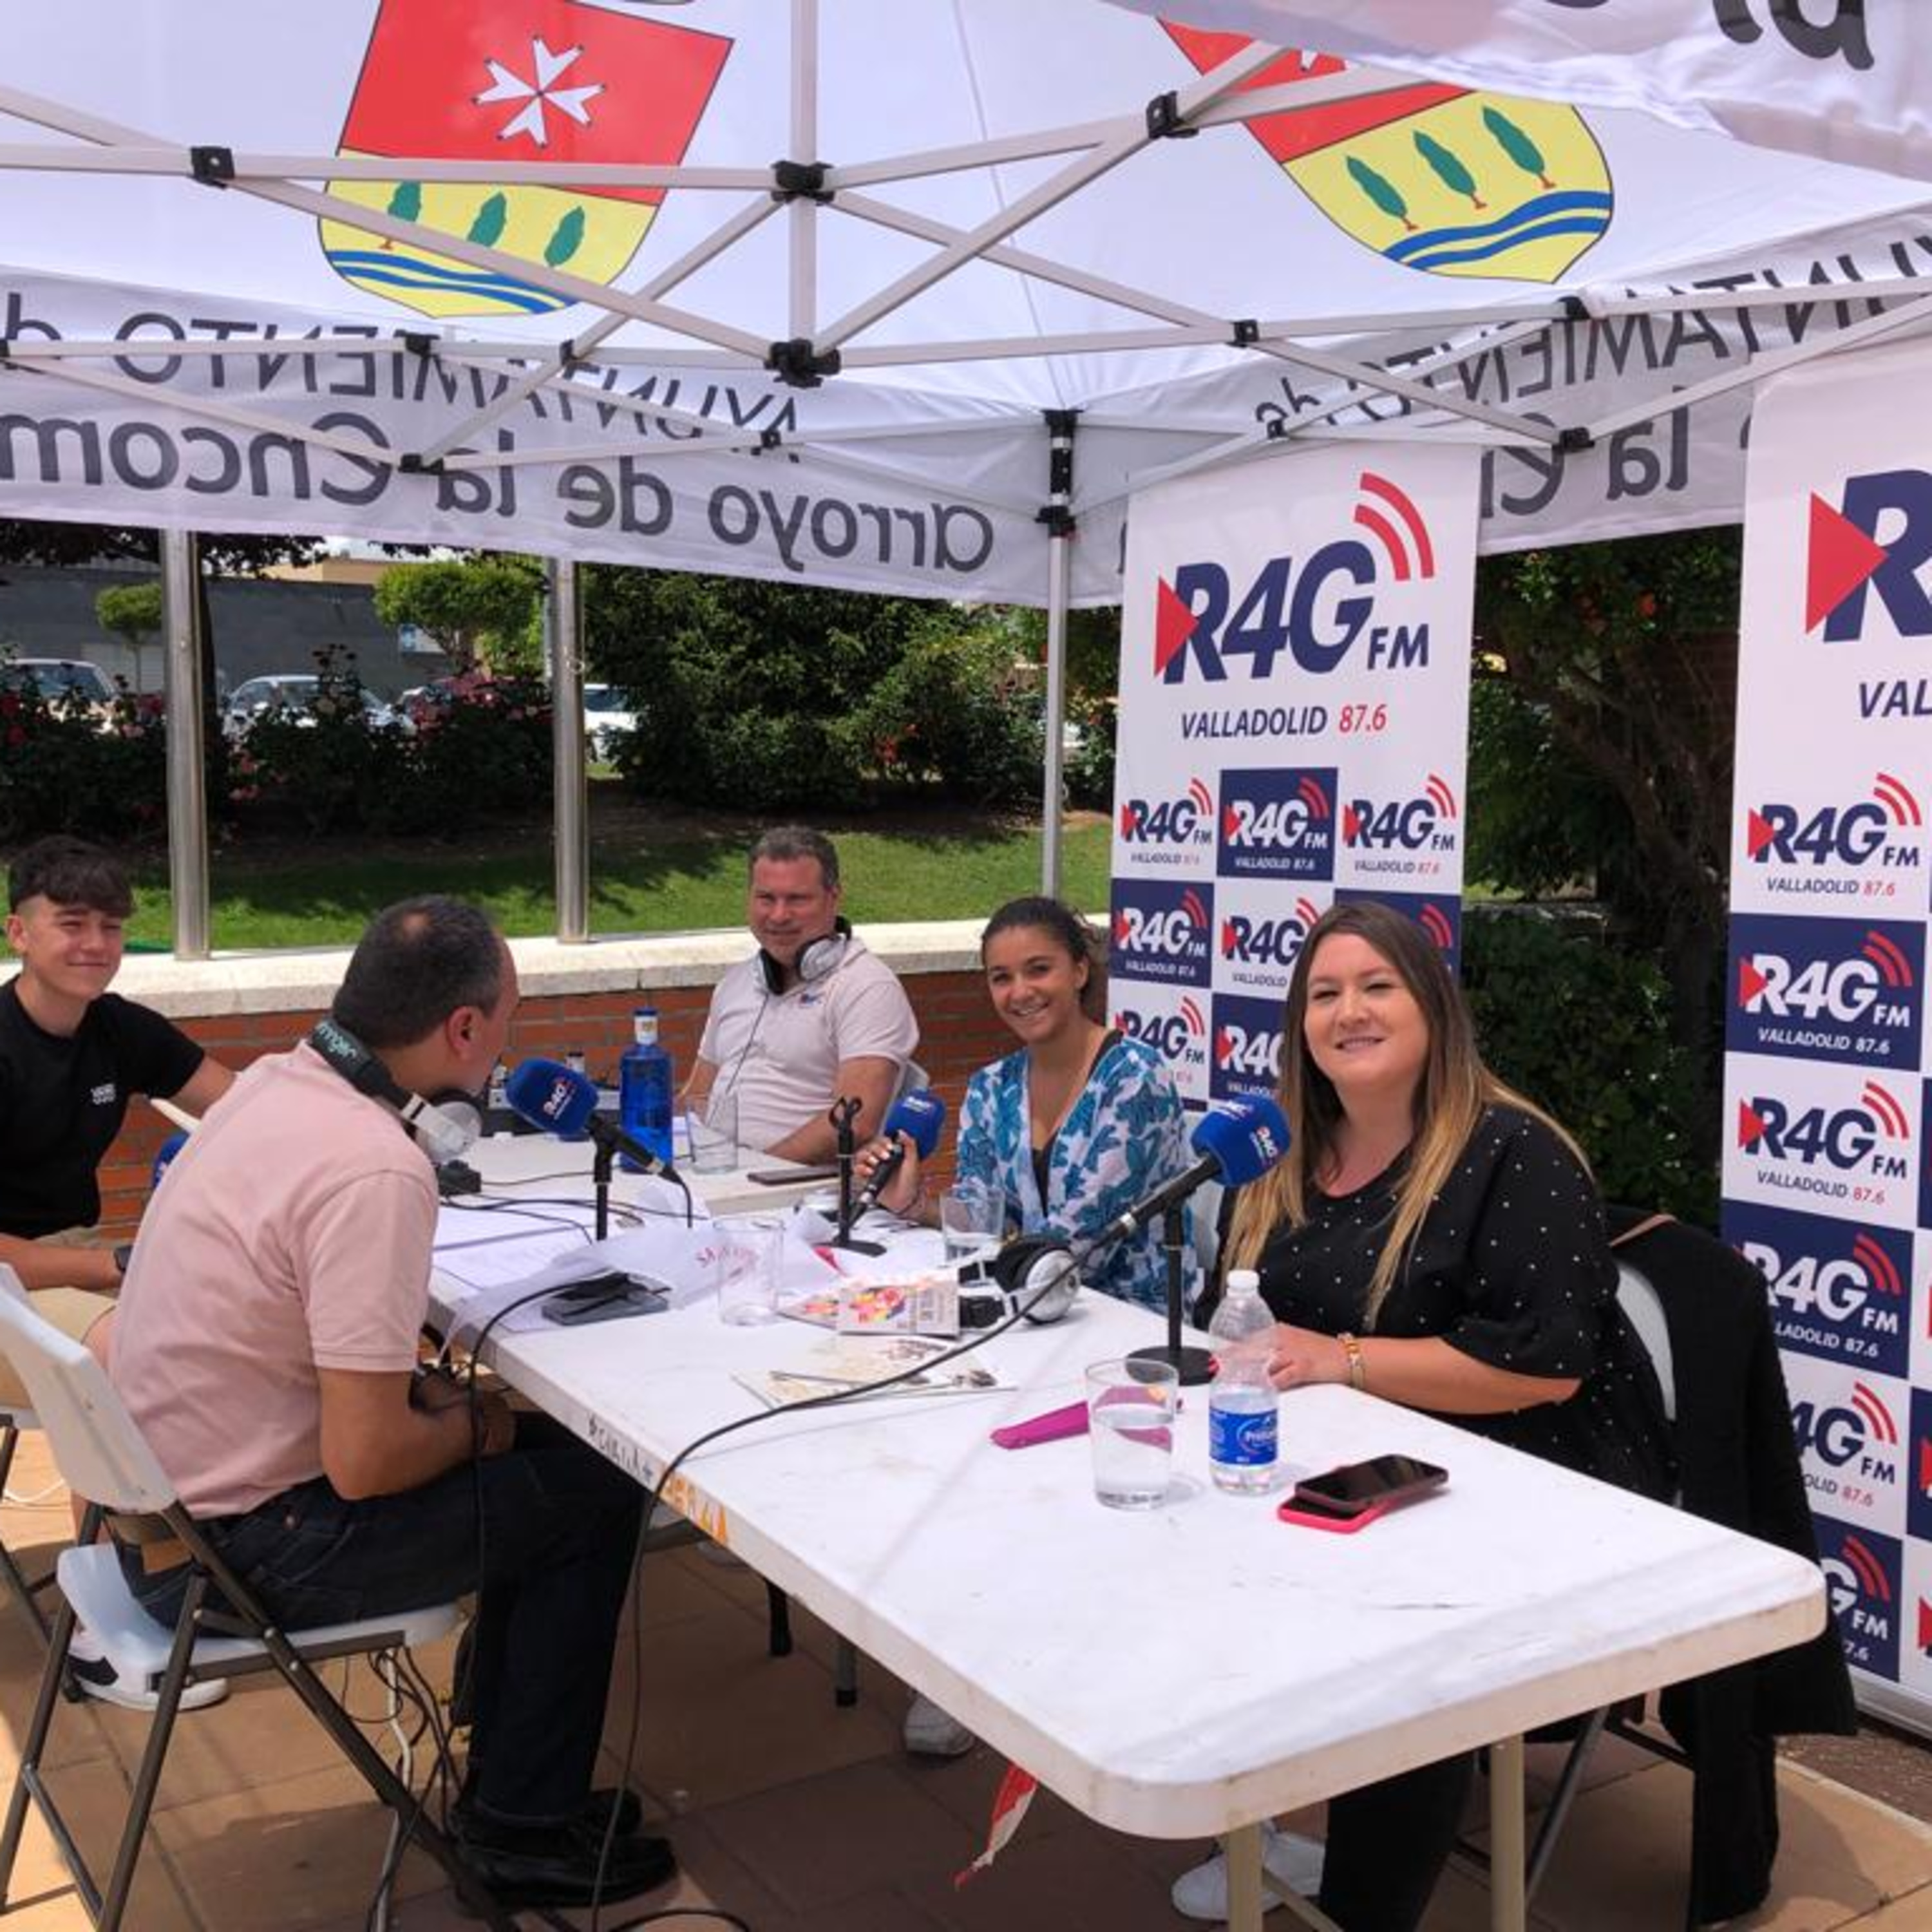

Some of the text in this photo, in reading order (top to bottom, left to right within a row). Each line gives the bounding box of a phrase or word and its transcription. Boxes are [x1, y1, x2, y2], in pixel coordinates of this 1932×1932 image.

[1163, 540, 1376, 685] R4G
[1367, 623, 1429, 670] FM
[1181, 704, 1387, 739] VALLADOLID 87.6
[1124, 799, 1212, 844] R4G FM
[1227, 799, 1329, 849] R4G FM
[1347, 799, 1455, 851] R4G FM
[1754, 802, 1920, 867] R4G FM
[1766, 877, 1859, 895] VALLADOLID
[1121, 907, 1191, 956] R4G
[1745, 952, 1911, 1028] R4G FM
[1757, 1027, 1891, 1055] VALLADOLID 87.6
[1745, 1096, 1908, 1179] R4G FM
[1757, 1170, 1848, 1198] VALLADOLID
[1861, 1307, 1899, 1335] FM
[1844, 1337, 1879, 1358] 87.6
[1861, 1456, 1895, 1484] FM
[1852, 1609, 1888, 1641] FM
